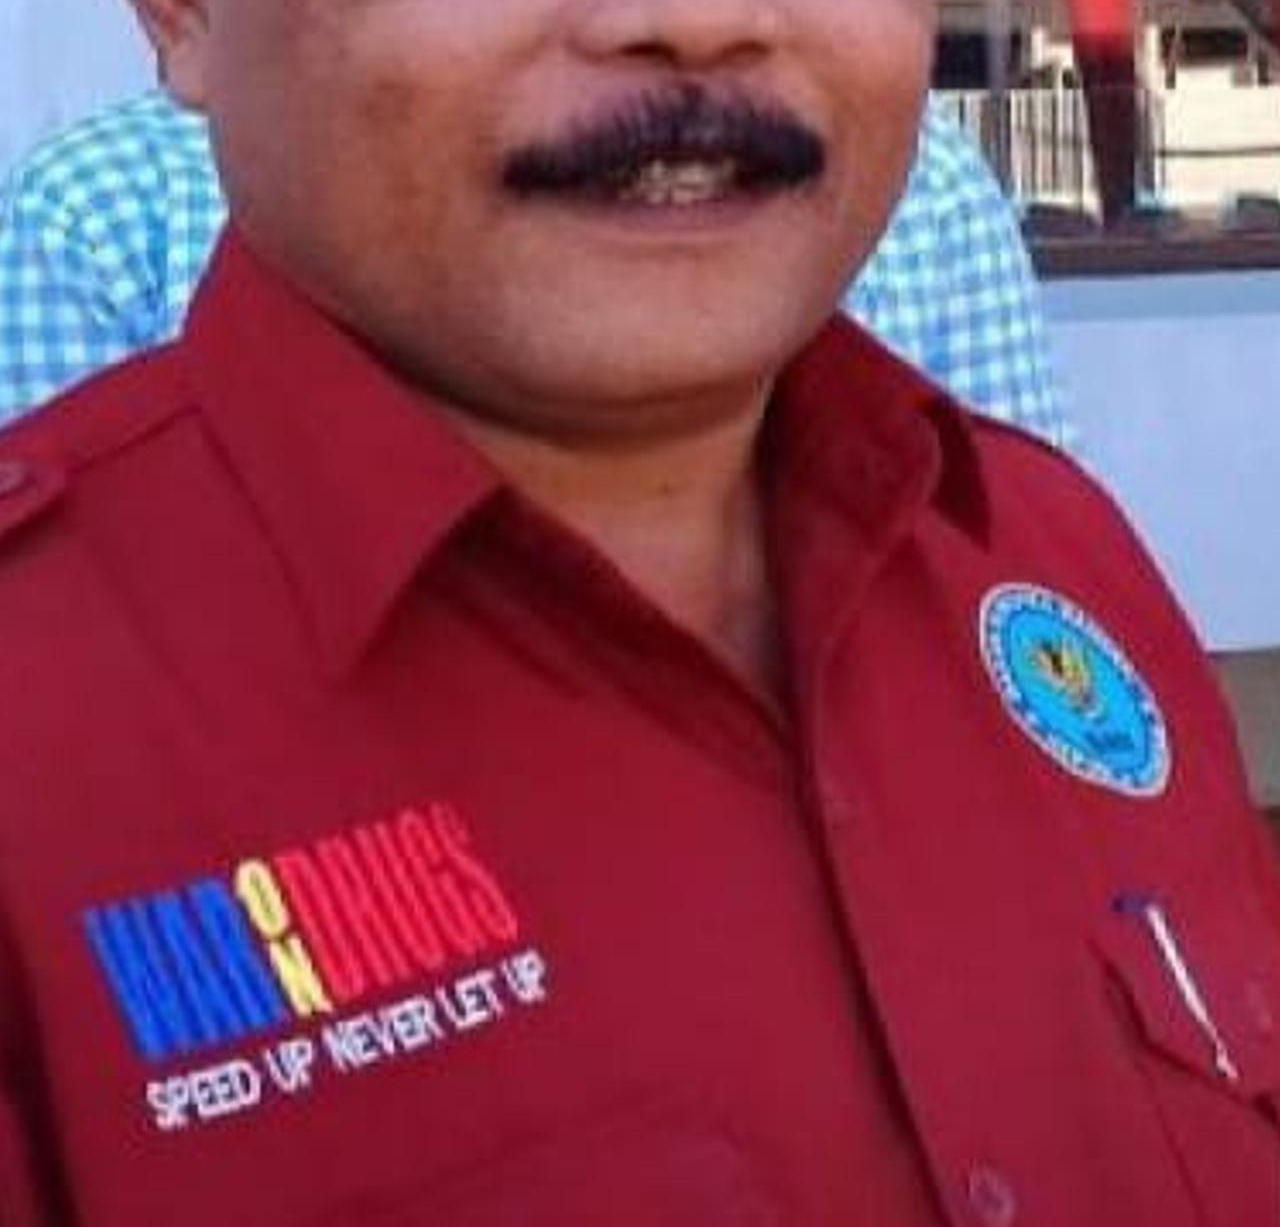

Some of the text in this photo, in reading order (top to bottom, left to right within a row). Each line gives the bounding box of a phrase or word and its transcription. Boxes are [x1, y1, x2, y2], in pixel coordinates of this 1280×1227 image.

[146, 948, 548, 1130] SPEED UP NEVER LET UP
